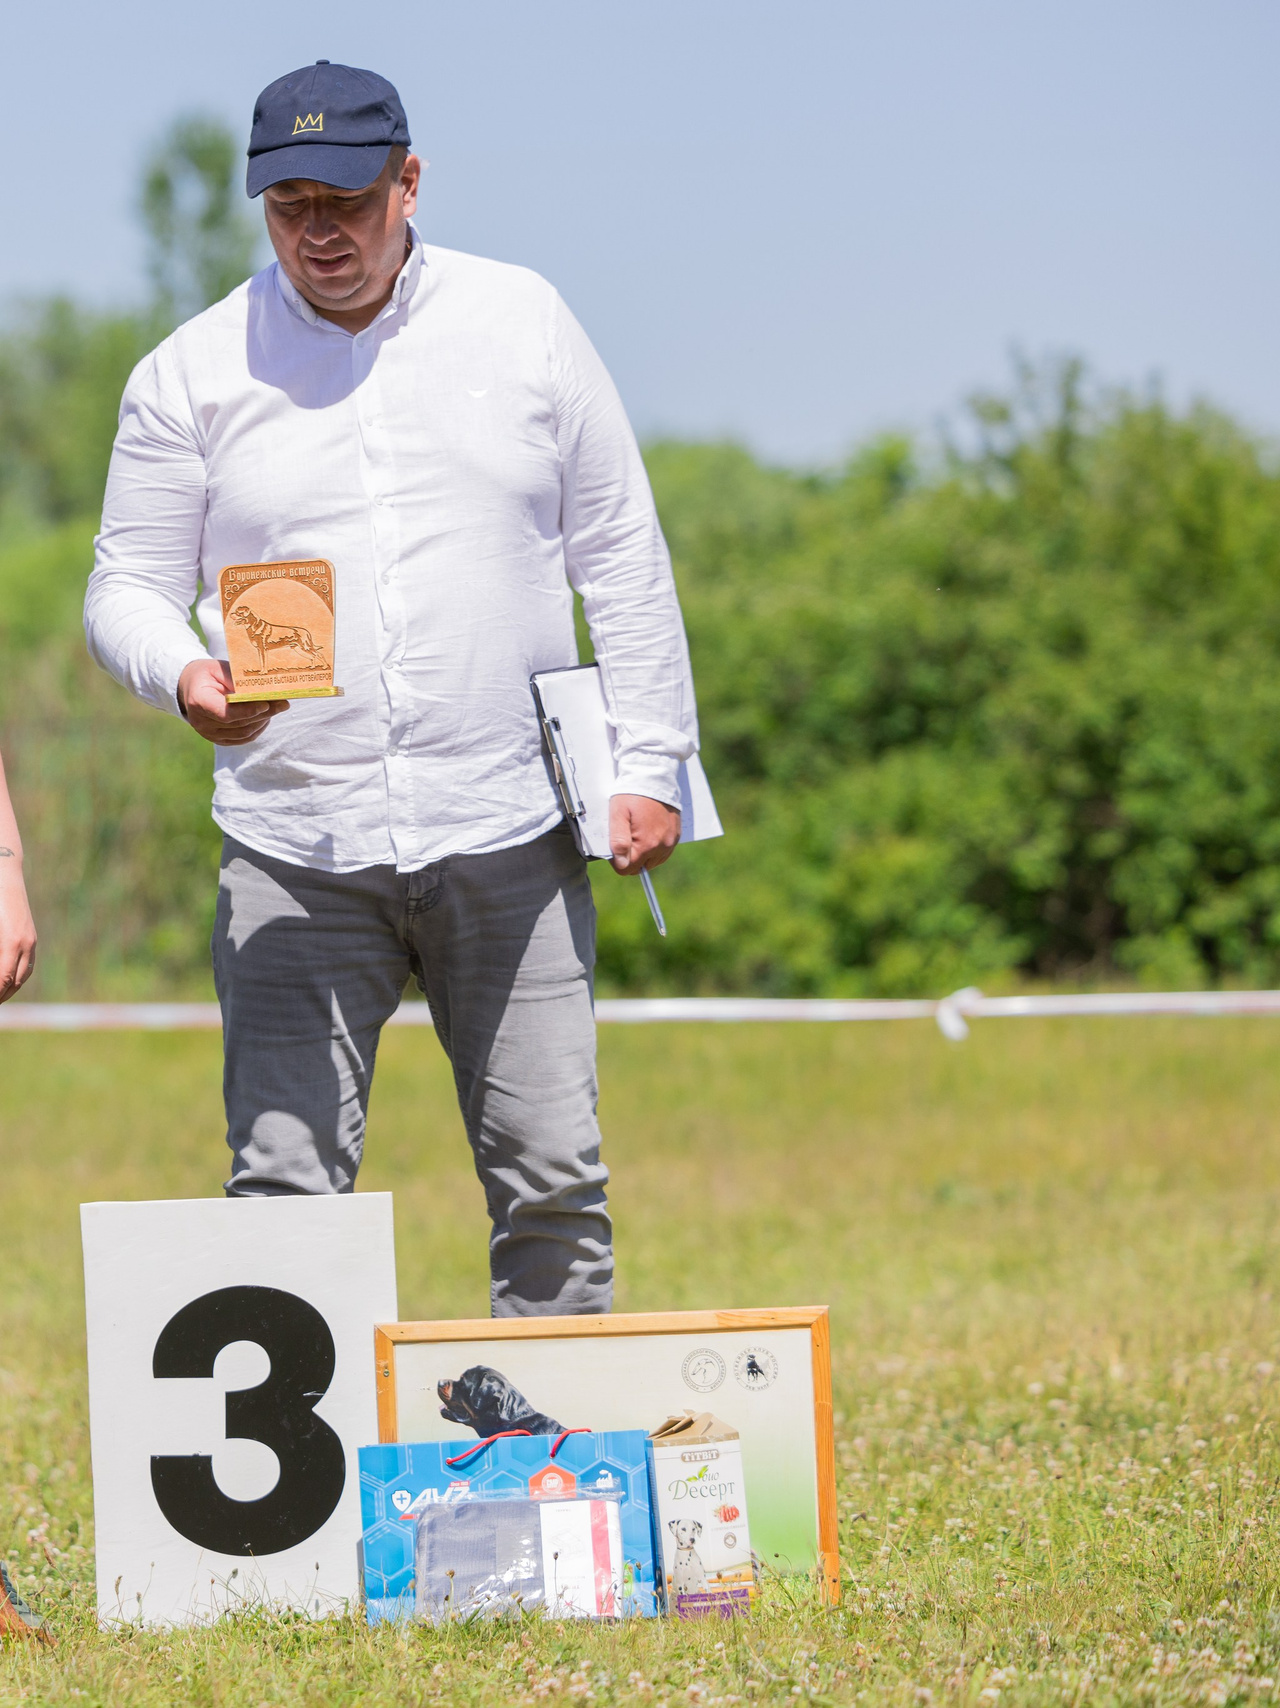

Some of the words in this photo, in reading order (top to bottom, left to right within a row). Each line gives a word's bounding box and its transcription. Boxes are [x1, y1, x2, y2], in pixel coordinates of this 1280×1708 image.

[229, 568, 286, 582] Воронежские
[289, 565, 326, 577] встречи
[274, 675, 299, 685] ВЫСТАВКА
[299, 672, 332, 683] РОТВЕЙЛЕРОВ
[150, 1285, 346, 1557] 3
